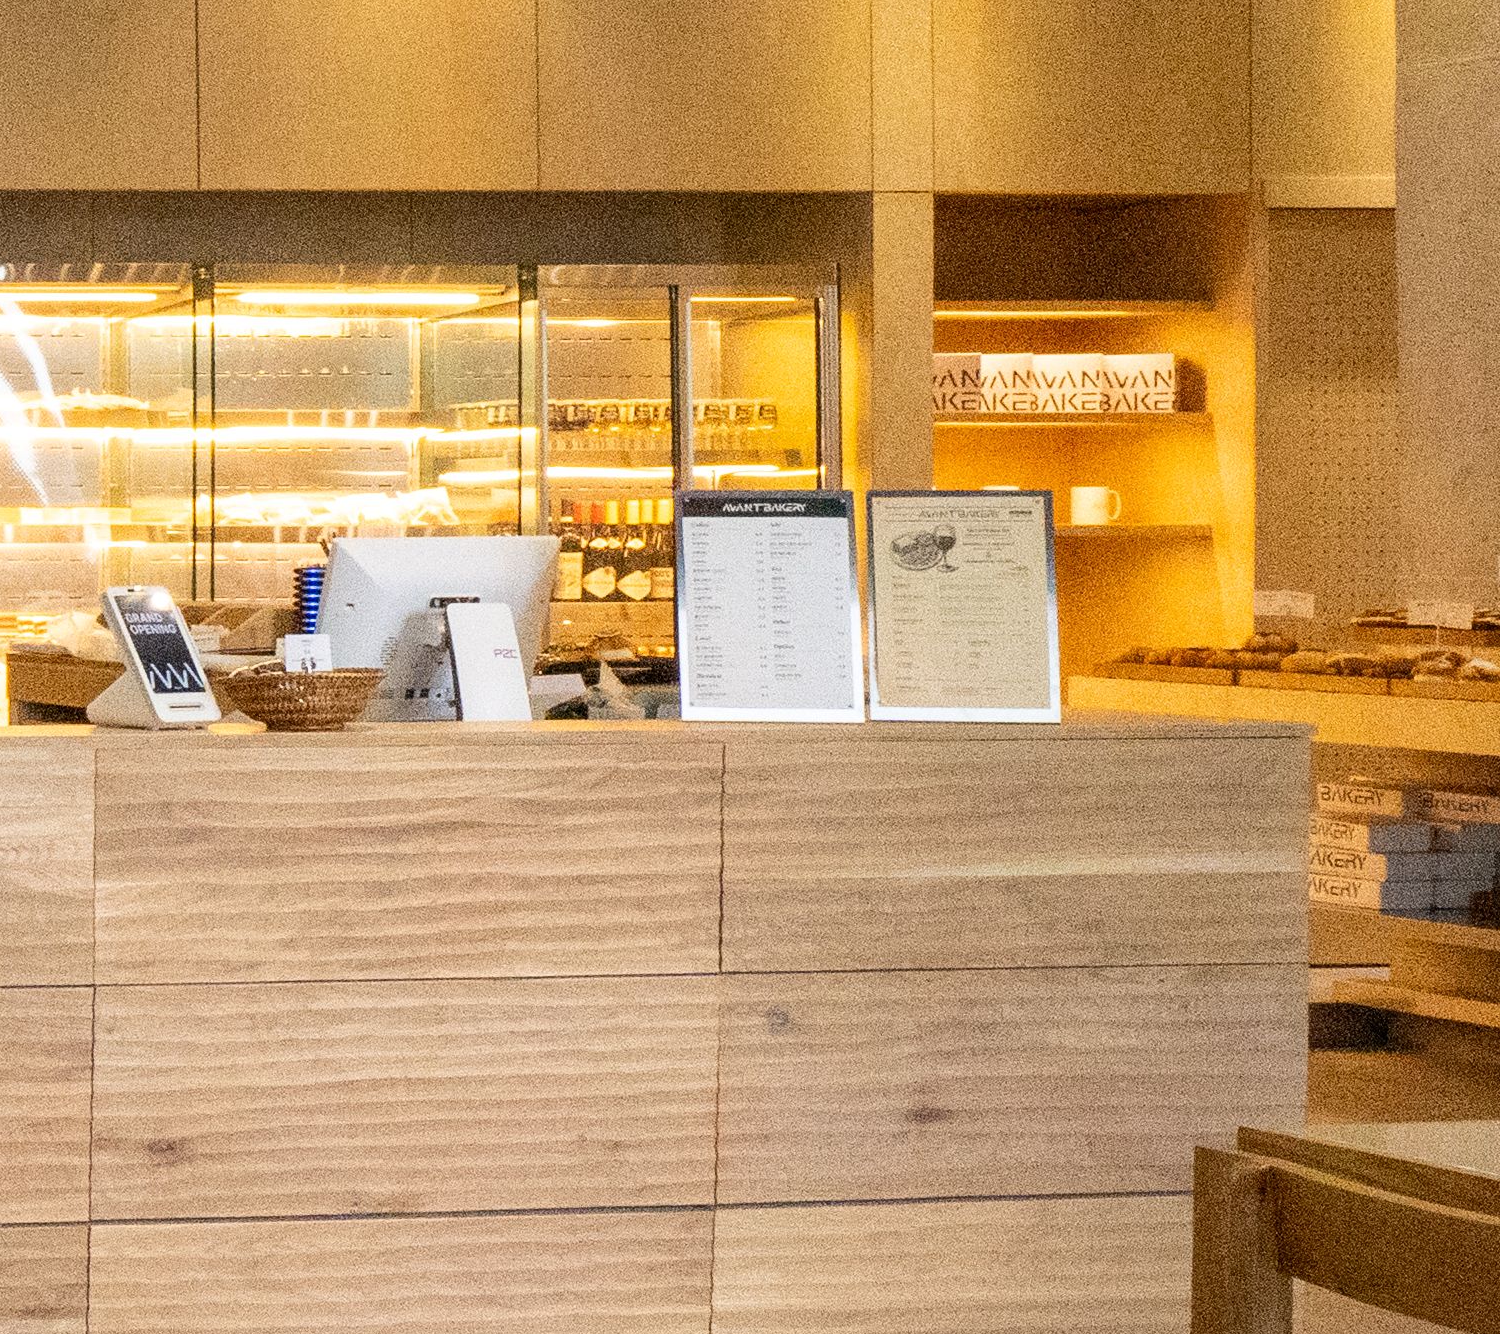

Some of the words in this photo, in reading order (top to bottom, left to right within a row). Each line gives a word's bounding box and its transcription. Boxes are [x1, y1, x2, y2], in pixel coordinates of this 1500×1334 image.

[722, 502, 764, 512] AVANT
[764, 503, 807, 512] BAKERY
[124, 612, 164, 623] GRAND
[129, 623, 178, 635] OPENING
[1320, 785, 1384, 805] BAKERY
[1310, 849, 1367, 870] AKERY
